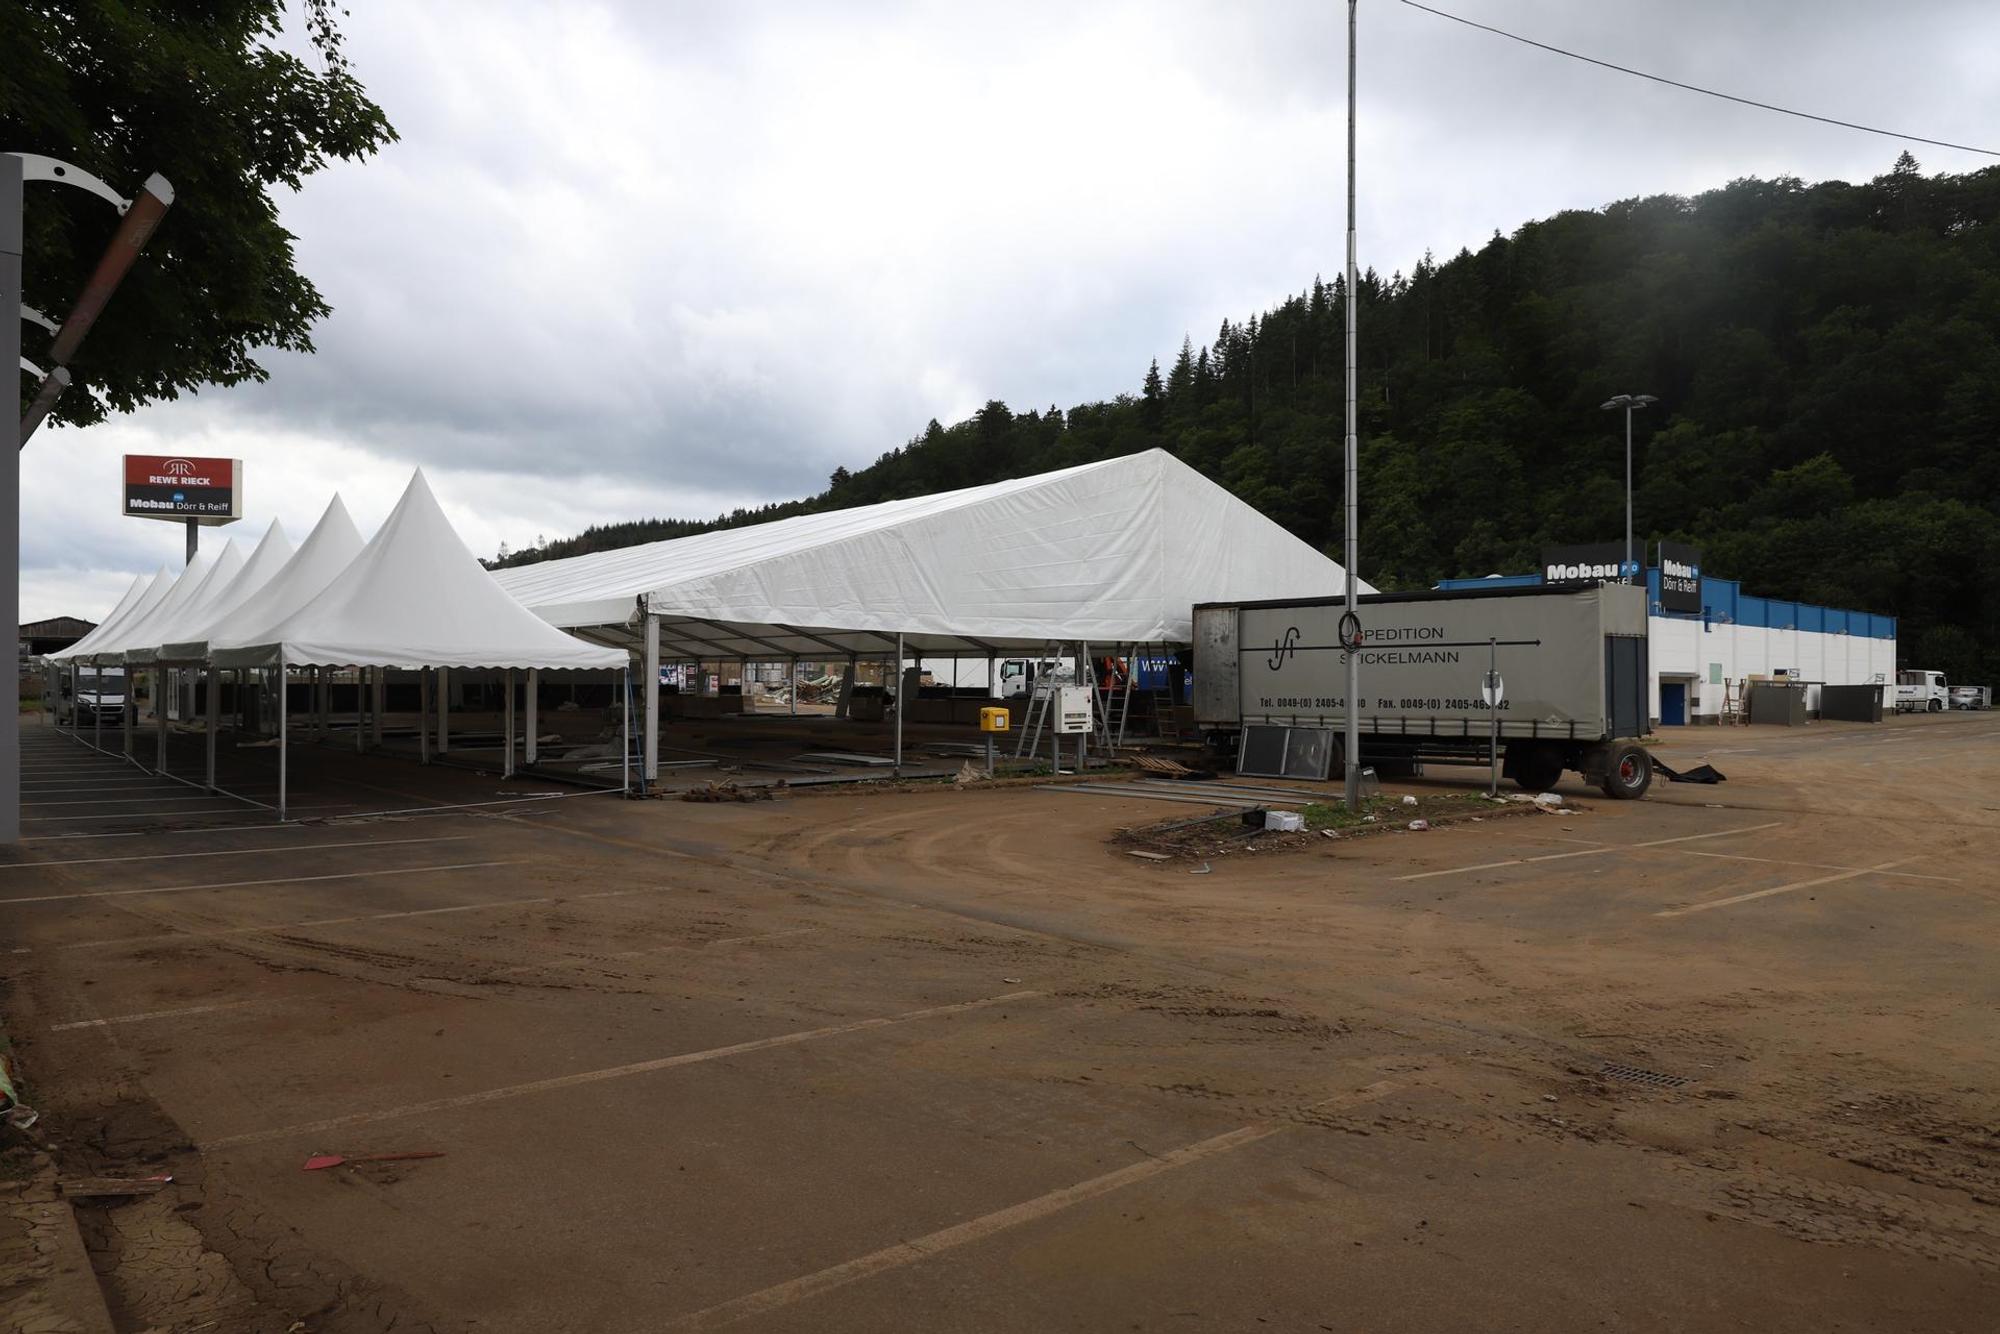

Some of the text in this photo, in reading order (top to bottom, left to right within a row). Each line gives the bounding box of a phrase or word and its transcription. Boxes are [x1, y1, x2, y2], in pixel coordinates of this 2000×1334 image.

[149, 475, 210, 486] REWE RIECK
[130, 499, 229, 511] Mobau Dörr & Reiff
[1547, 563, 1618, 580] Mobau
[1663, 559, 1692, 578] Mobau
[1359, 627, 1444, 641] PEDITION
[1340, 651, 1459, 665] SICKELMANN
[1260, 698, 1274, 708] Tel.
[1378, 699, 1396, 709] Fax.
[1400, 699, 1440, 710] 0049-(0)
